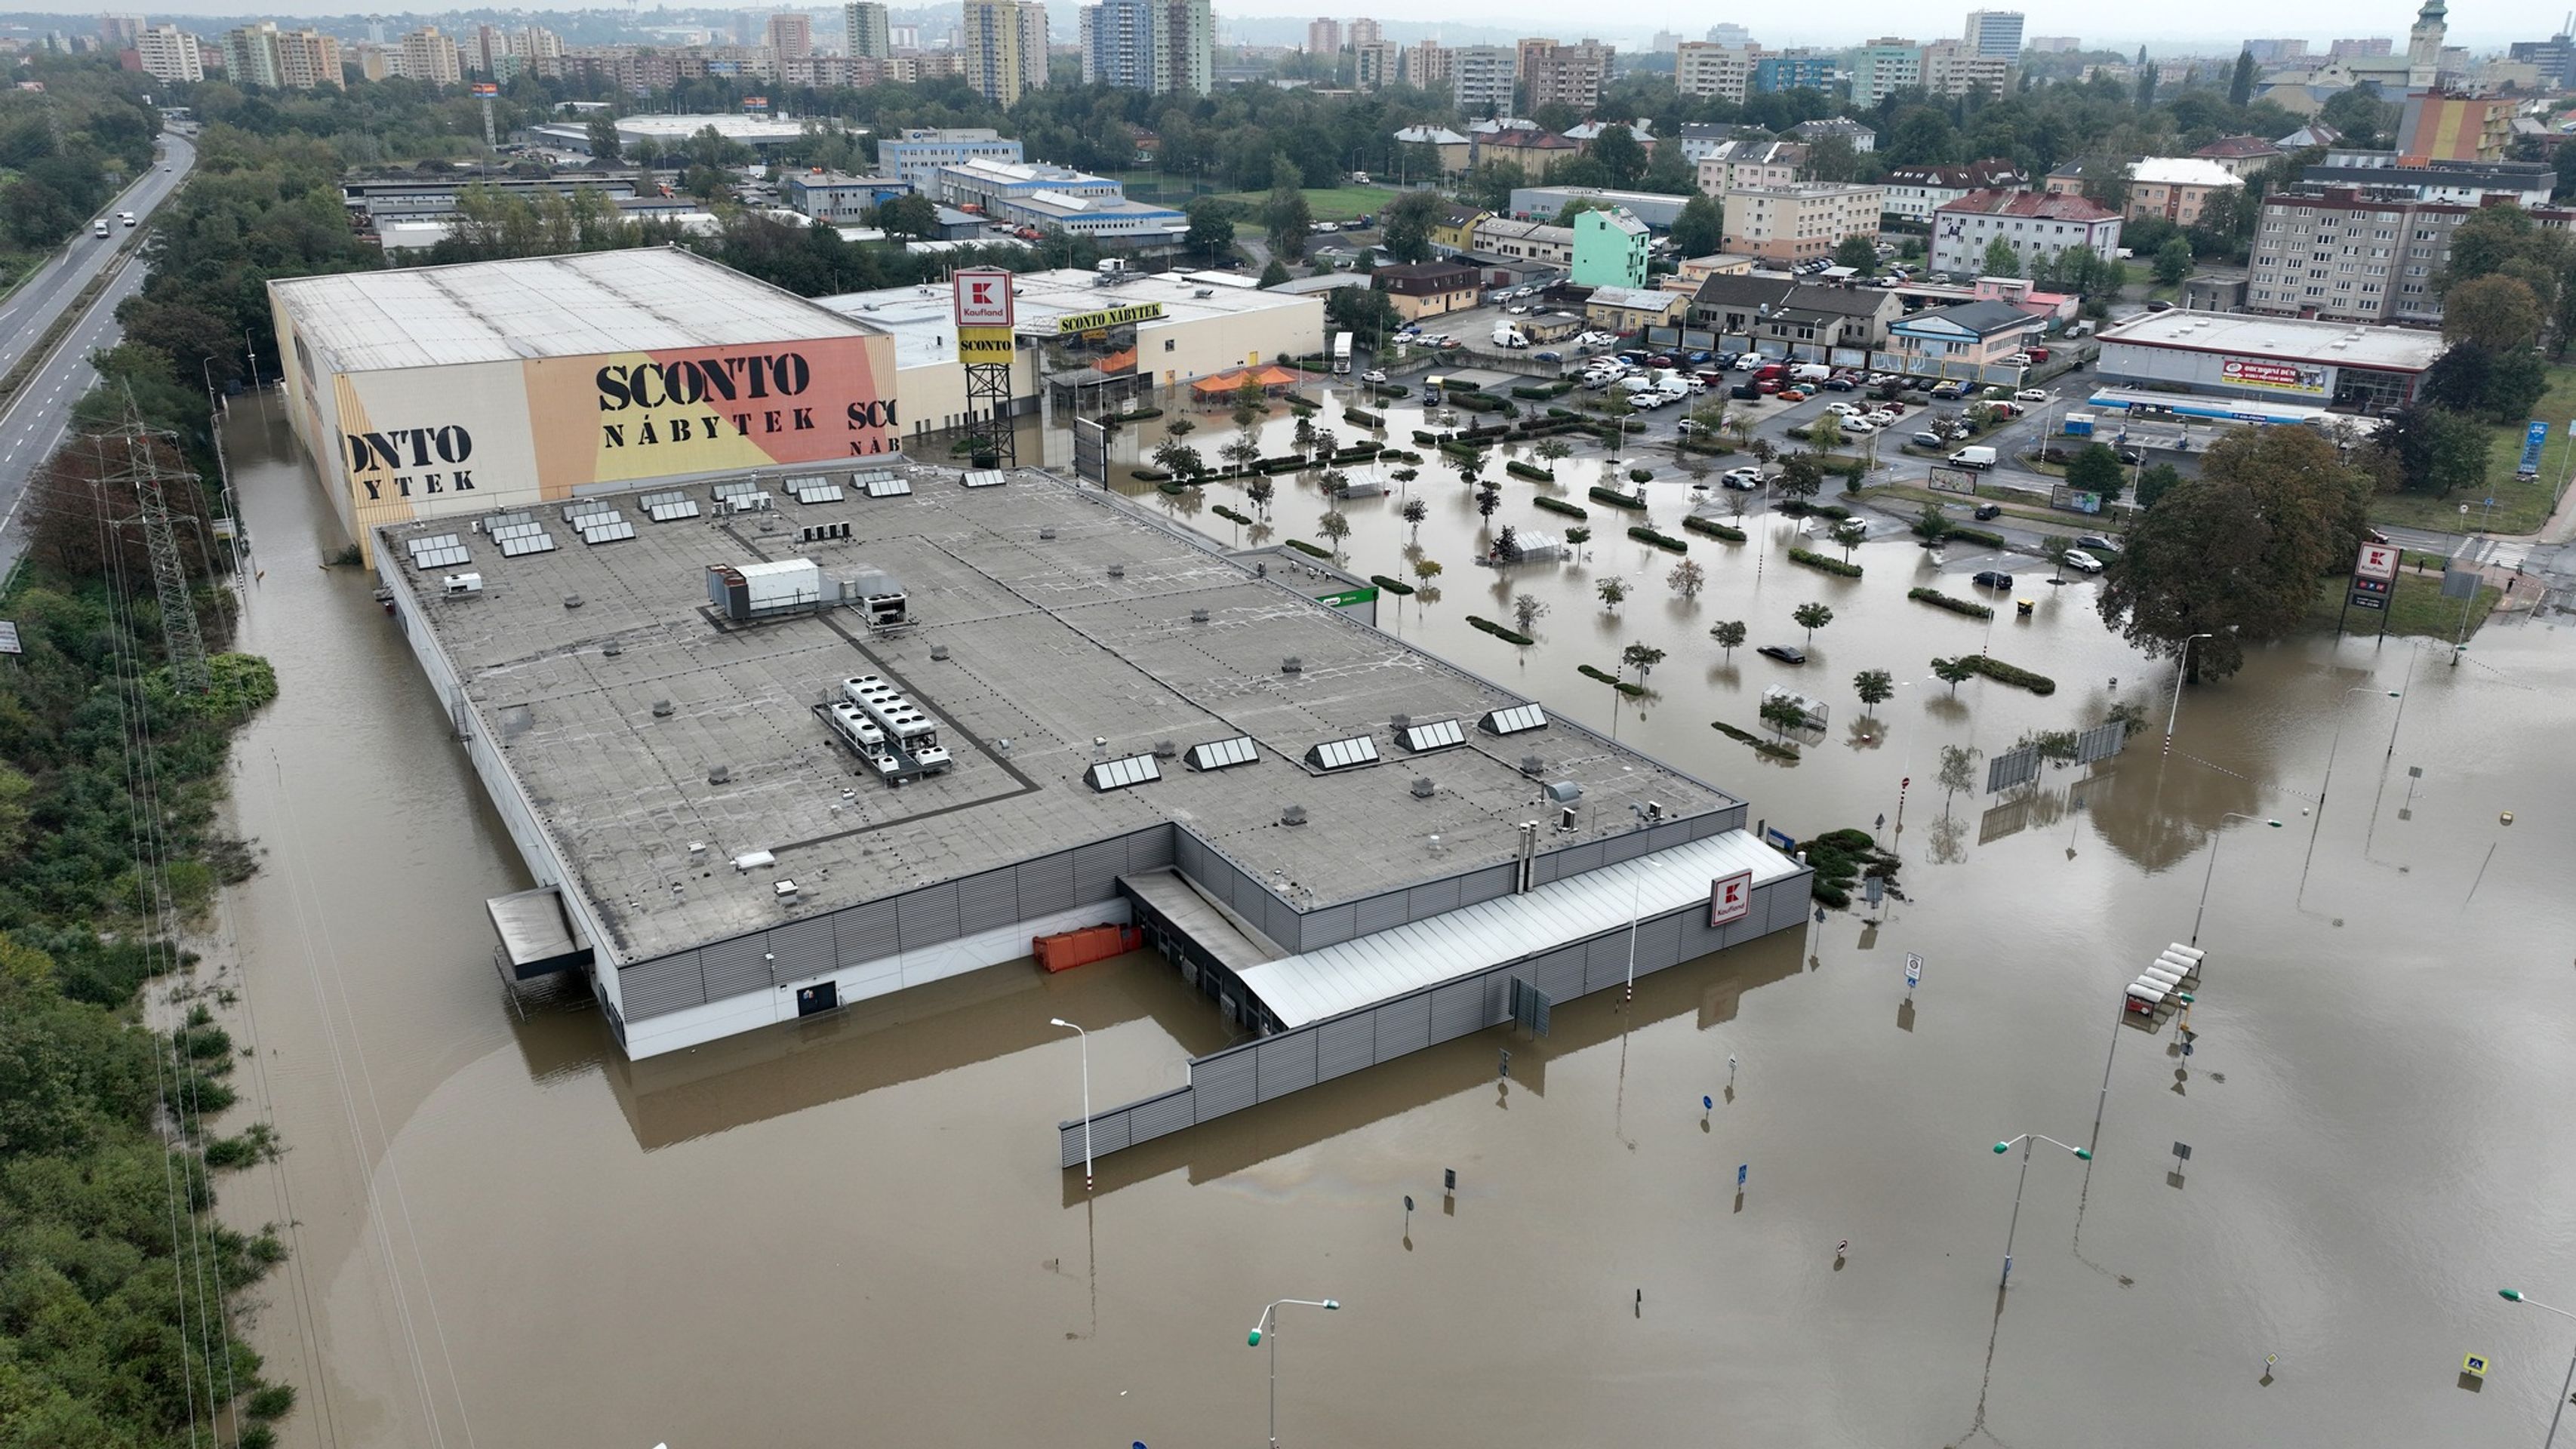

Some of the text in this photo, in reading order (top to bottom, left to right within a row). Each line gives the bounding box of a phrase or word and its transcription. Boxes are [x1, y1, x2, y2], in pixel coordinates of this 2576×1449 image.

[964, 308, 1003, 317] Kaufland
[1061, 313, 1105, 332] SCONTO
[961, 340, 1011, 351] SCONTO
[596, 352, 810, 411] SCONTO
[603, 408, 814, 448] NÁBYTEK
[363, 470, 475, 500] YTEK
[1717, 902, 1745, 916] Kaufland
